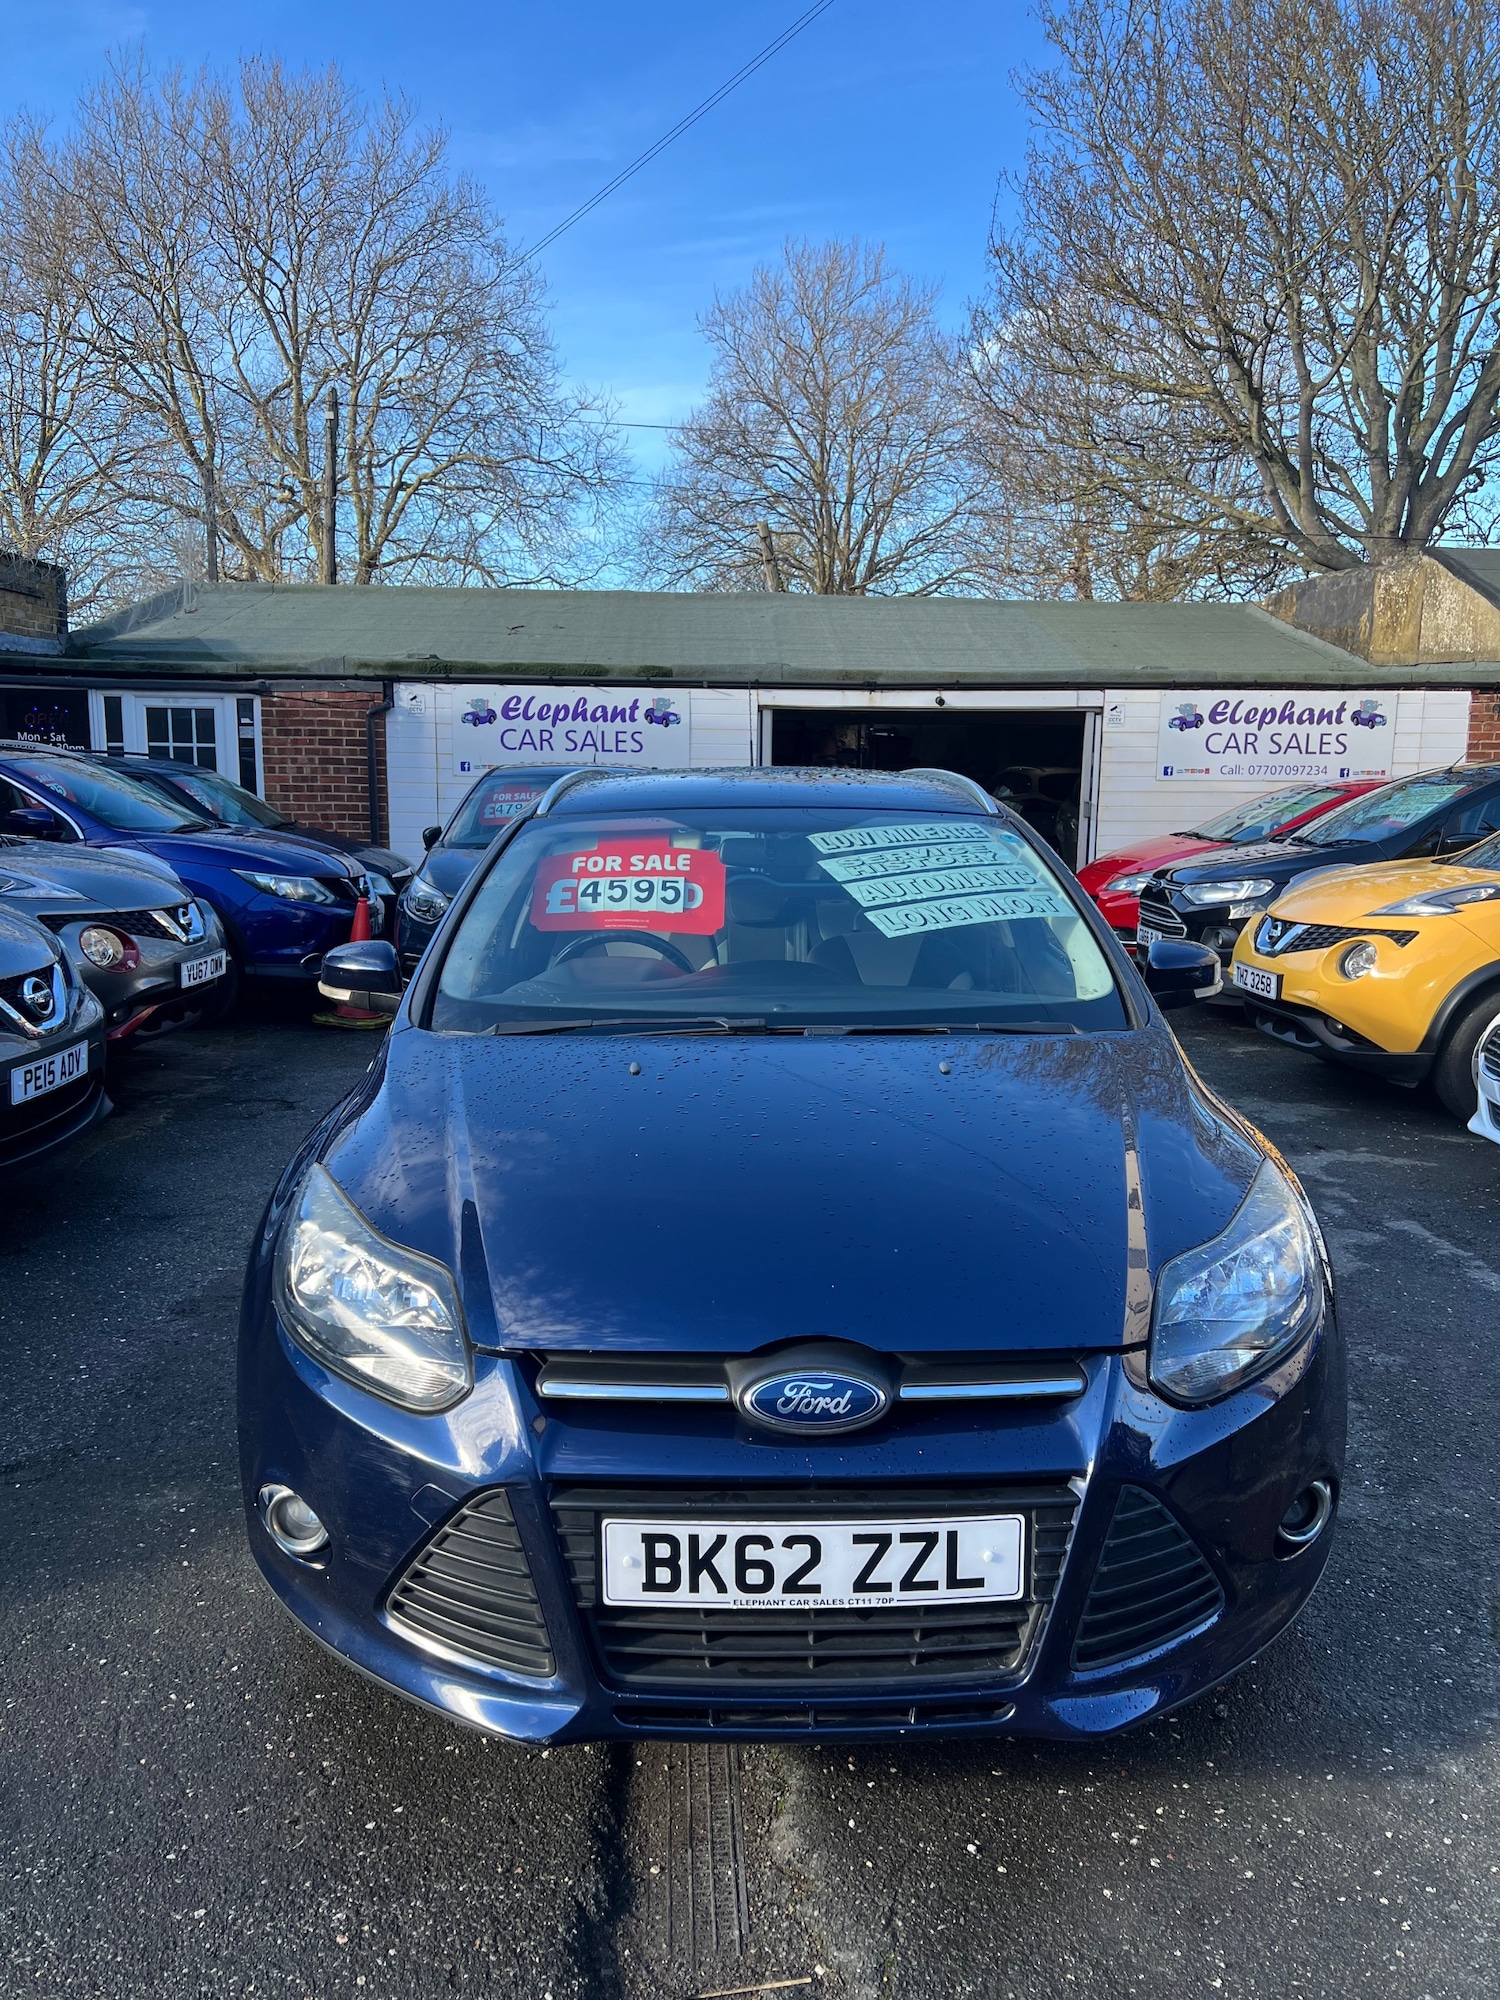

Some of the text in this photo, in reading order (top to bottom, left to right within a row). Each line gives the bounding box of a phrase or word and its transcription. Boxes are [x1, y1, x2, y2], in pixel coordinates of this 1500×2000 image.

[500, 695, 640, 728] Elephant
[1208, 699, 1347, 731] Elephant
[17, 732, 40, 741] Mon
[50, 732, 66, 742] Sat
[500, 728, 644, 753] CAR SALES
[1205, 732, 1348, 755] CAR SALES
[1220, 764, 1244, 776] Call:
[1248, 765, 1328, 776] 07707097234
[493, 792, 537, 801] FOR SALE
[484, 803, 523, 818] £479
[815, 824, 991, 850] LOW MILEAGE
[571, 854, 691, 873] FOR SALE
[836, 843, 990, 867] SERVICE
[844, 851, 1000, 877] HISTORY
[857, 867, 1038, 901] AUTOMATIC
[875, 901, 973, 932] LONG
[186, 960, 208, 982] VU67
[1236, 965, 1272, 994] THZ 3258
[24, 1047, 81, 1096] PE15 ADV
[776, 1381, 853, 1415] Ford
[640, 1530, 985, 1595] BK62 ZZL
[875, 1597, 895, 1605] 7DP
